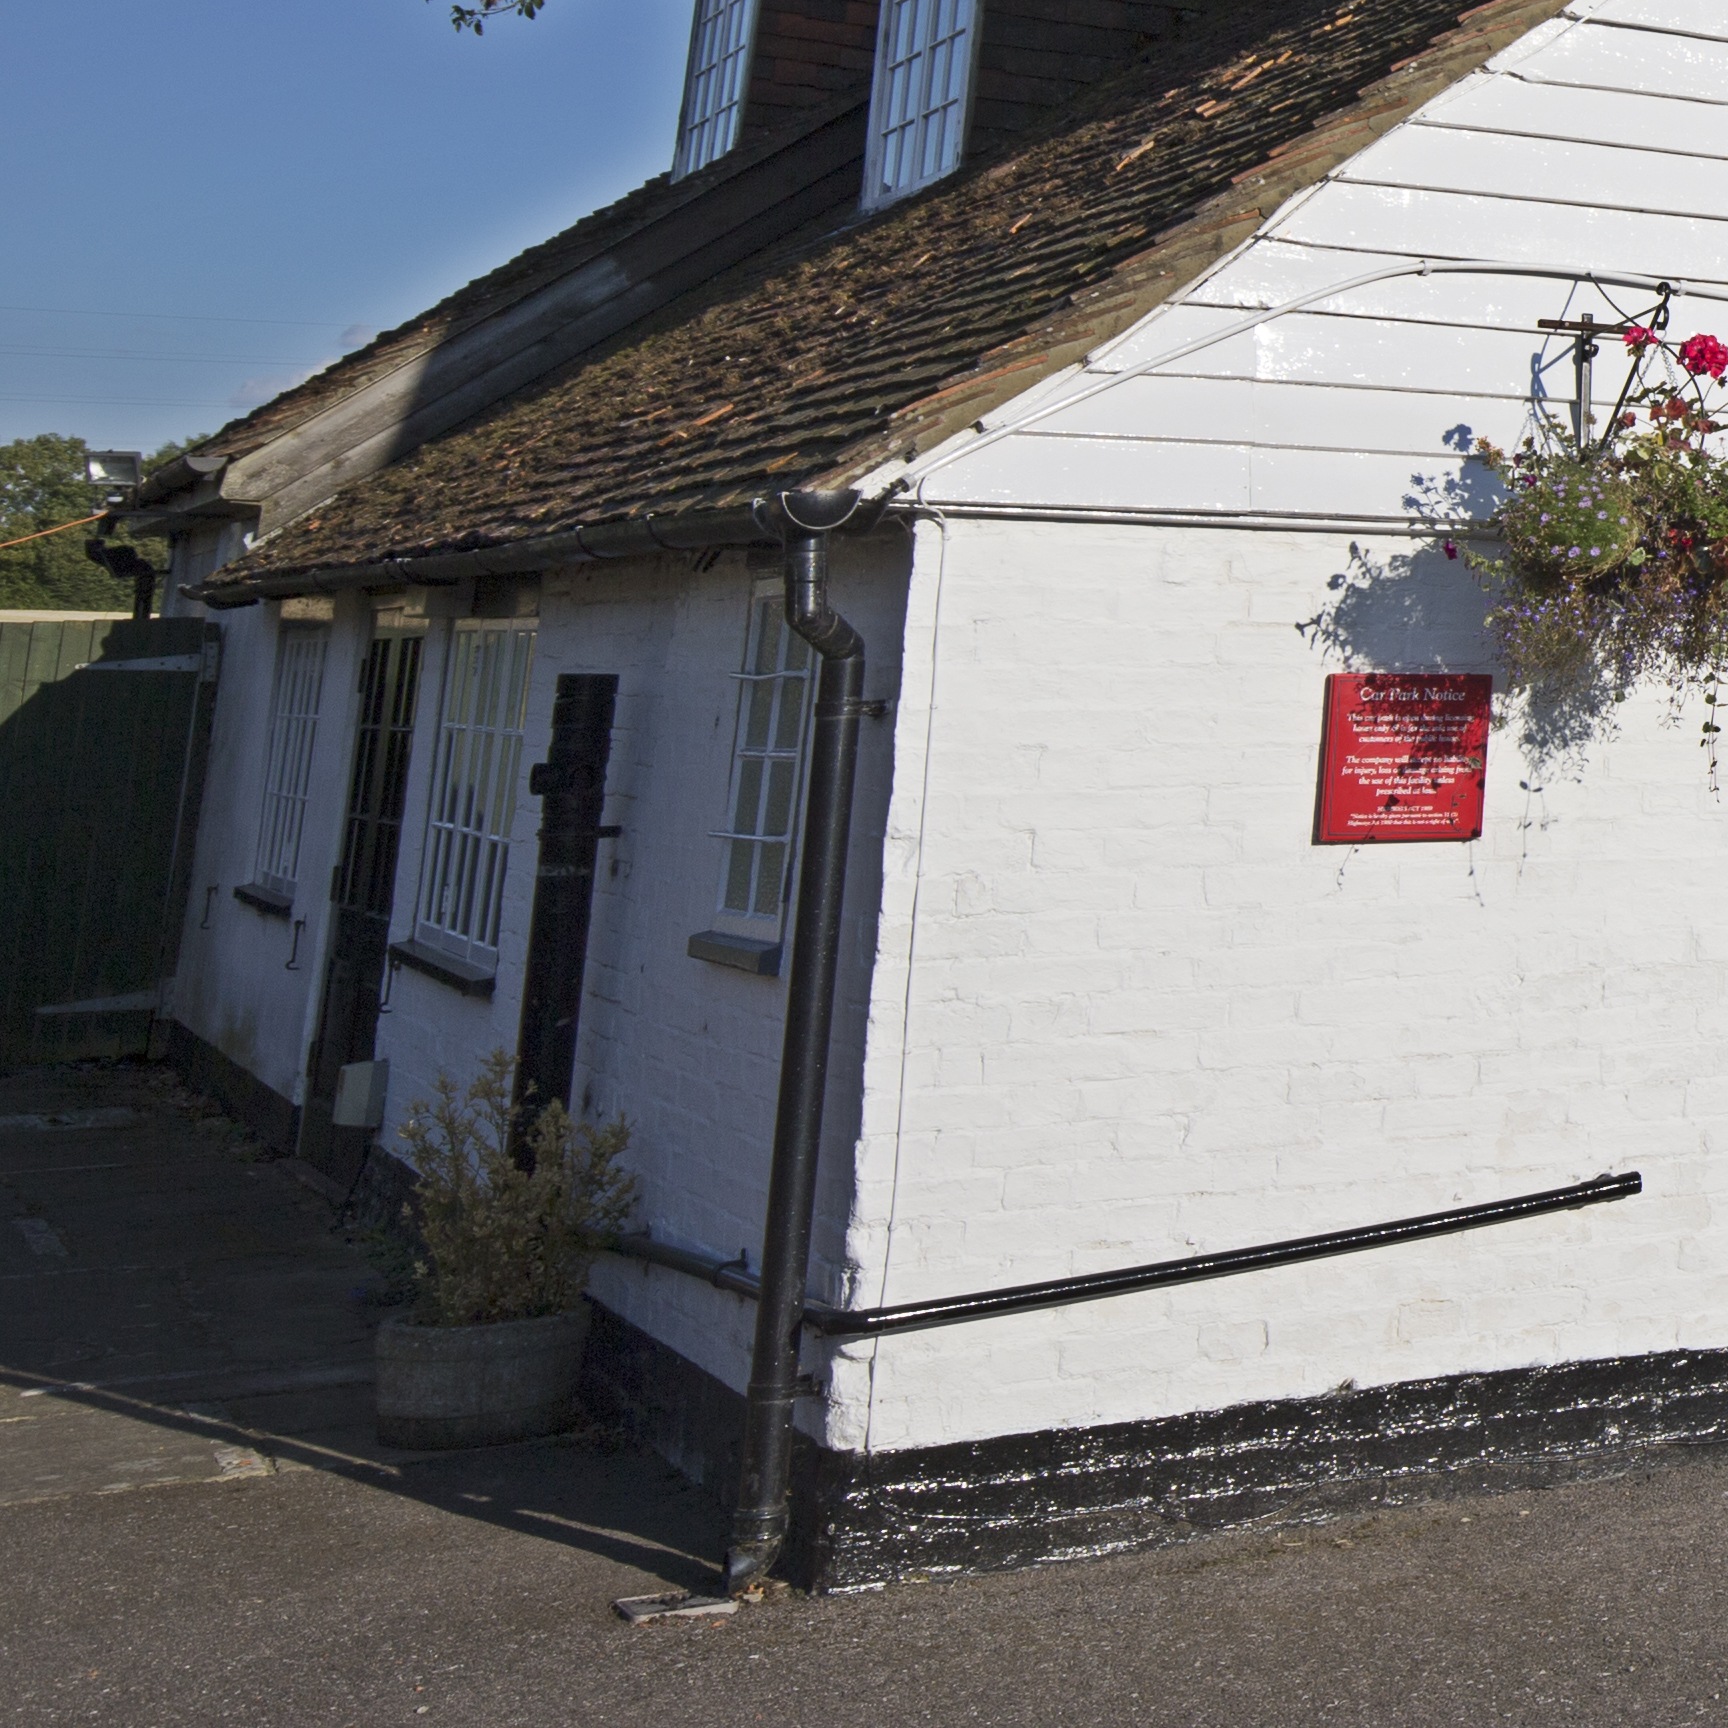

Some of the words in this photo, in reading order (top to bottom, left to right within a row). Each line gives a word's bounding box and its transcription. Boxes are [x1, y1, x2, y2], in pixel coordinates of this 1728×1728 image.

[1360, 686, 1385, 701] Car
[1389, 687, 1419, 701] Park
[1423, 687, 1465, 701] Notice
